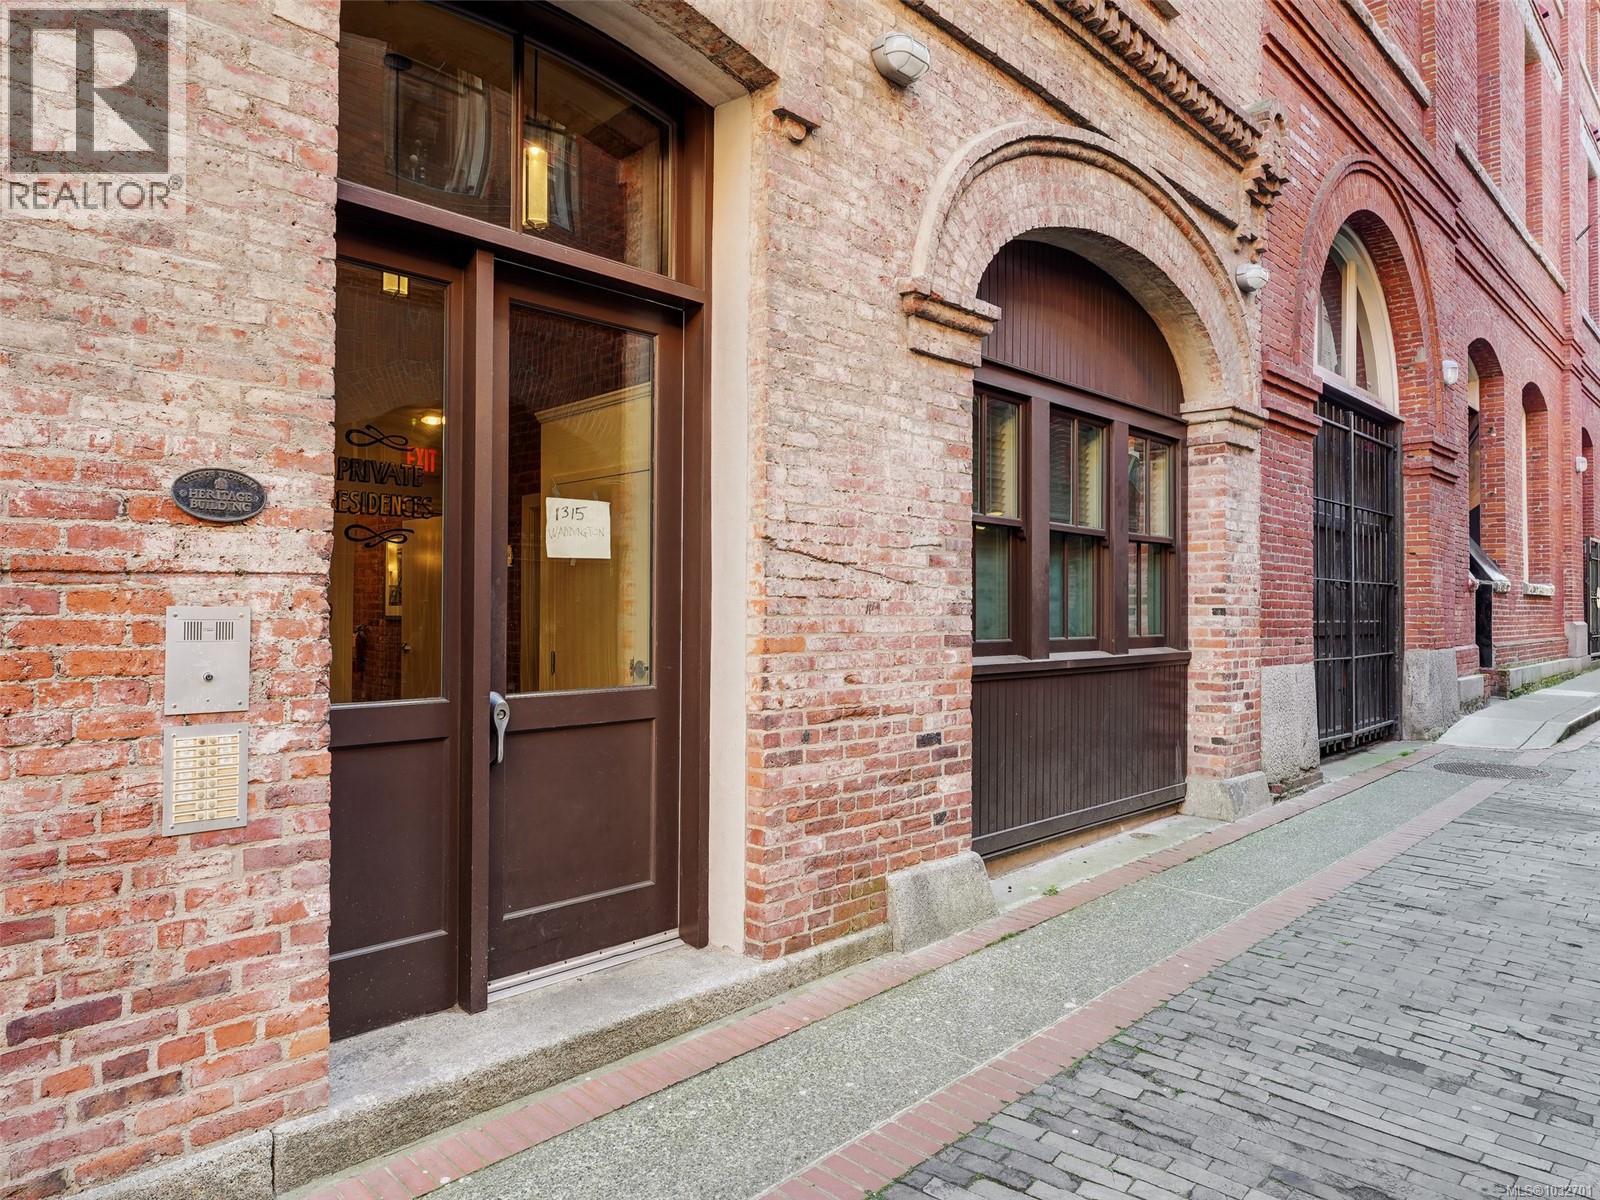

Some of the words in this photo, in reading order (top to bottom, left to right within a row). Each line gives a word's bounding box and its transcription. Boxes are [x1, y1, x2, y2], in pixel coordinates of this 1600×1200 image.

[405, 447, 437, 473] EXIT
[219, 471, 259, 489] VICTORIA
[337, 457, 424, 487] PRIVATE
[188, 488, 253, 501] HERITAGE
[190, 499, 252, 512] BUILDING
[555, 505, 589, 521] 1315
